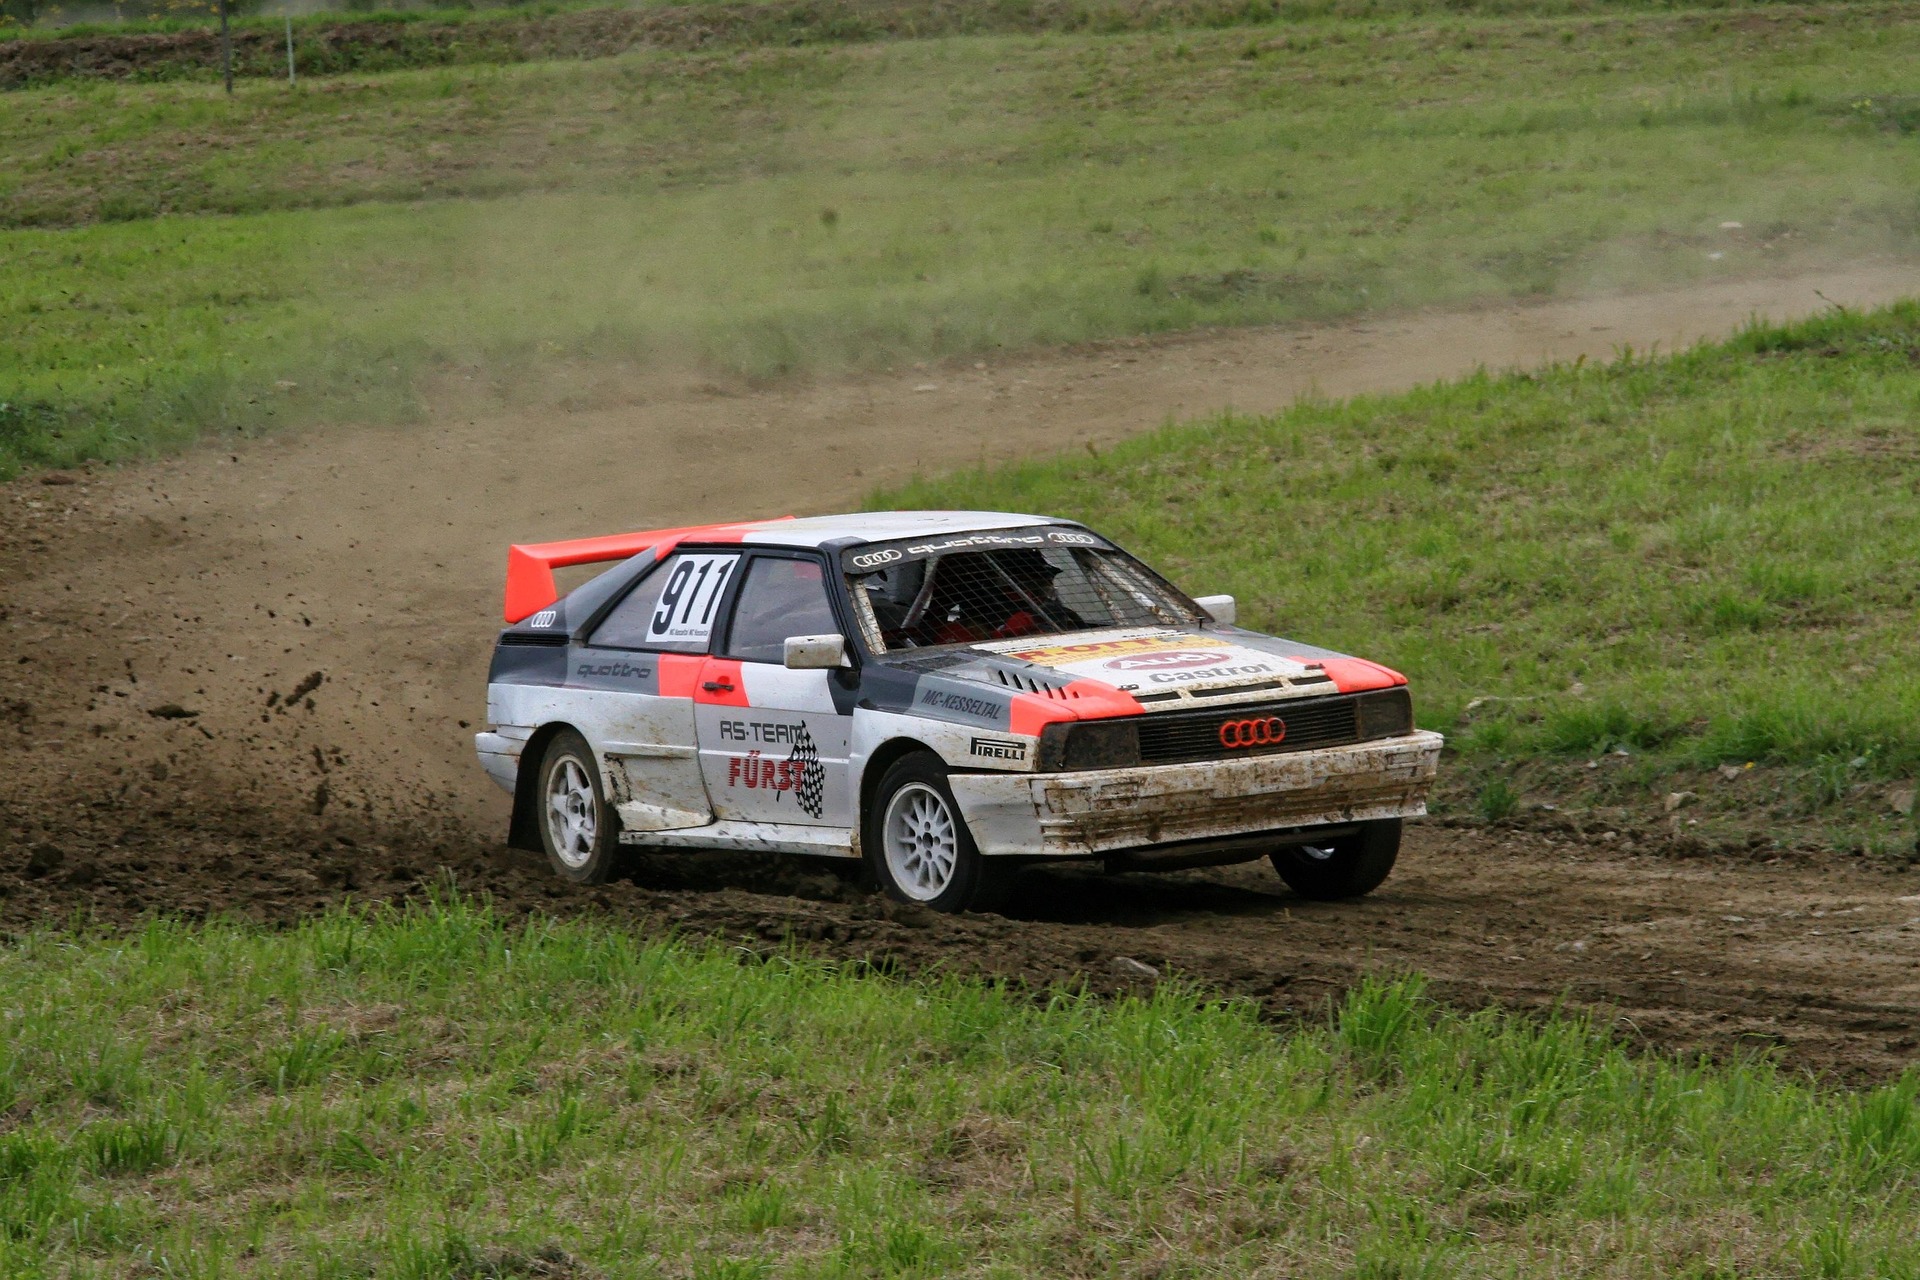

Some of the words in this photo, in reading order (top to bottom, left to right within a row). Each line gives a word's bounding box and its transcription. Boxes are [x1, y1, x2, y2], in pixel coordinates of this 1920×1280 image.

[652, 560, 734, 635] 911
[577, 662, 651, 678] quattro
[1149, 664, 1273, 683] Castrol
[922, 689, 1002, 719] MC-KESSELTAL
[970, 737, 1027, 760] PIRELLI
[728, 750, 806, 792] FÜRST
